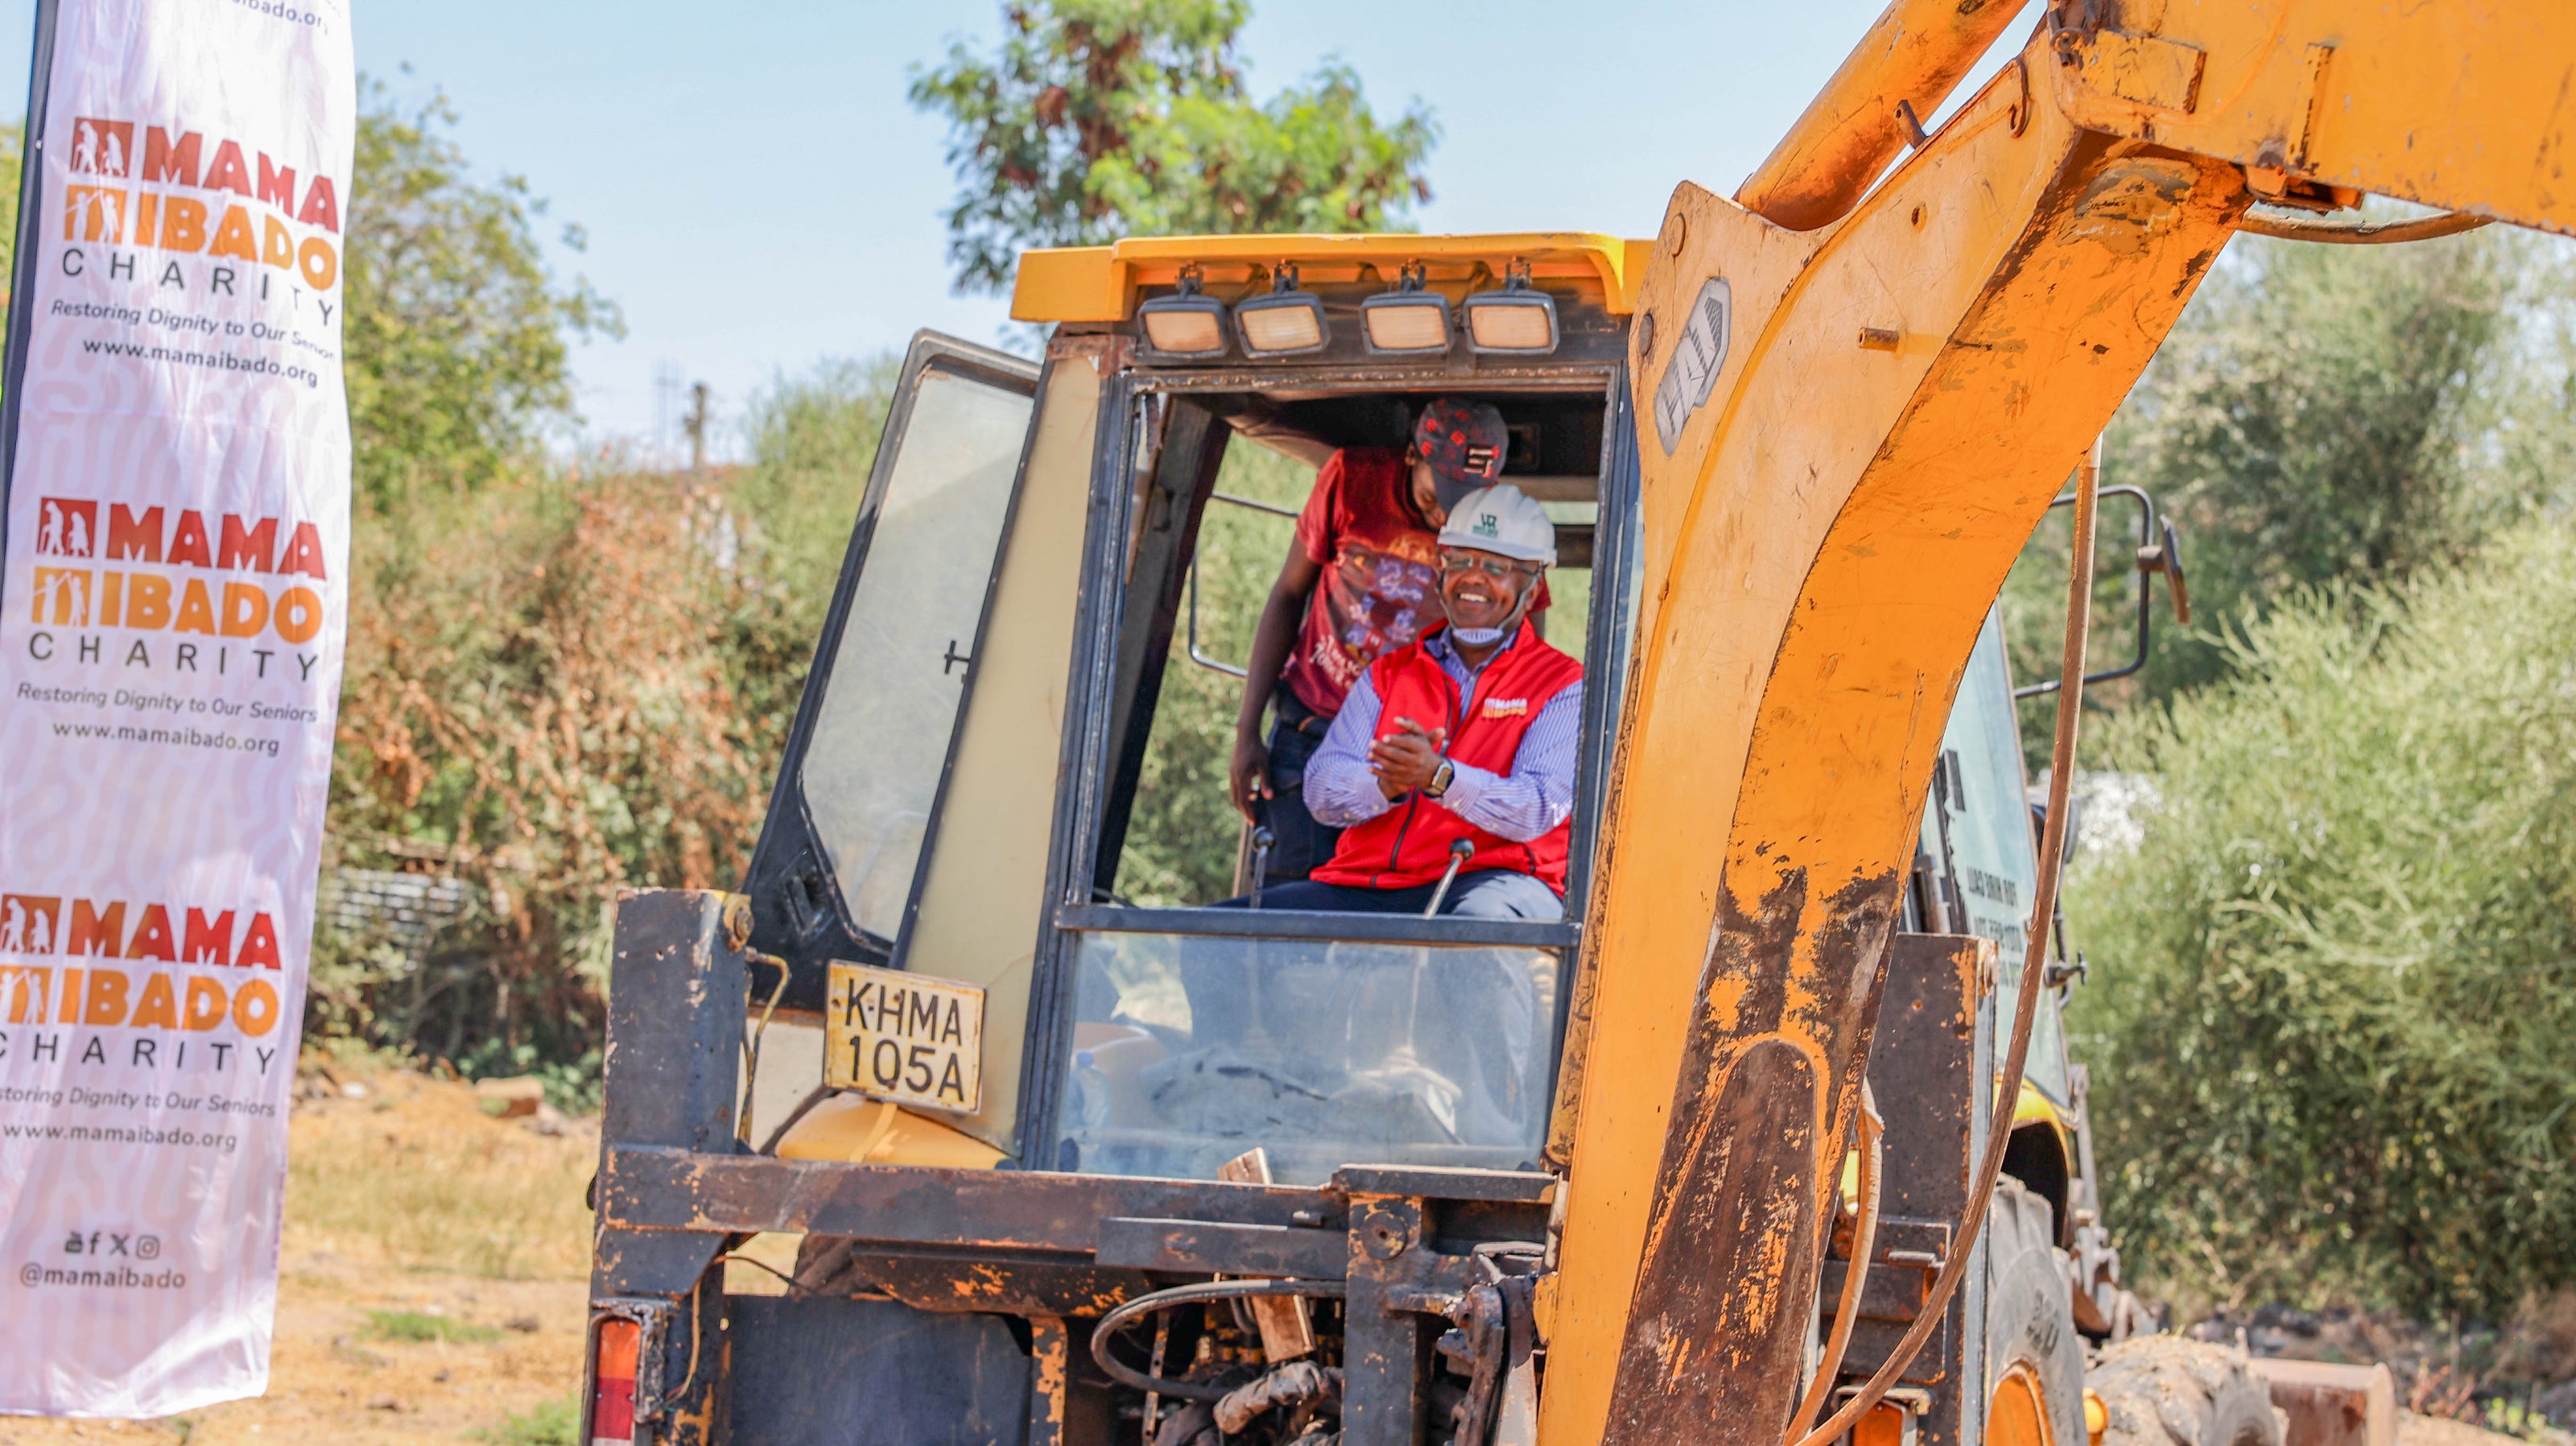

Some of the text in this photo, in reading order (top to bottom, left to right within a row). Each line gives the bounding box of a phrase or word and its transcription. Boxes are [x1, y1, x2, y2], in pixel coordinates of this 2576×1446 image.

[142, 126, 339, 234] MAMA
[134, 191, 336, 291] IBADO
[63, 248, 333, 326] CHARITY
[52, 299, 141, 325] Restoring
[148, 308, 219, 336] Dignity
[225, 320, 244, 336] to
[251, 322, 287, 341] Our
[83, 339, 318, 388] www.mamaibado.org
[105, 502, 327, 581] MAMA
[99, 570, 324, 644] IBADO
[28, 631, 319, 682] CHARITY
[17, 682, 318, 723] Restoring Dignity to Our Seniors
[53, 723, 279, 758] www.mamaibado.org
[67, 899, 282, 970] MAMA
[59, 968, 279, 1037] IBADO
[849, 1035, 964, 1101] 105A
[0, 1086, 276, 1118] toring Dignity to Our Seniors
[3, 1123, 237, 1154] www.mamaibado.org
[20, 1262, 187, 1288] @mamaibado
